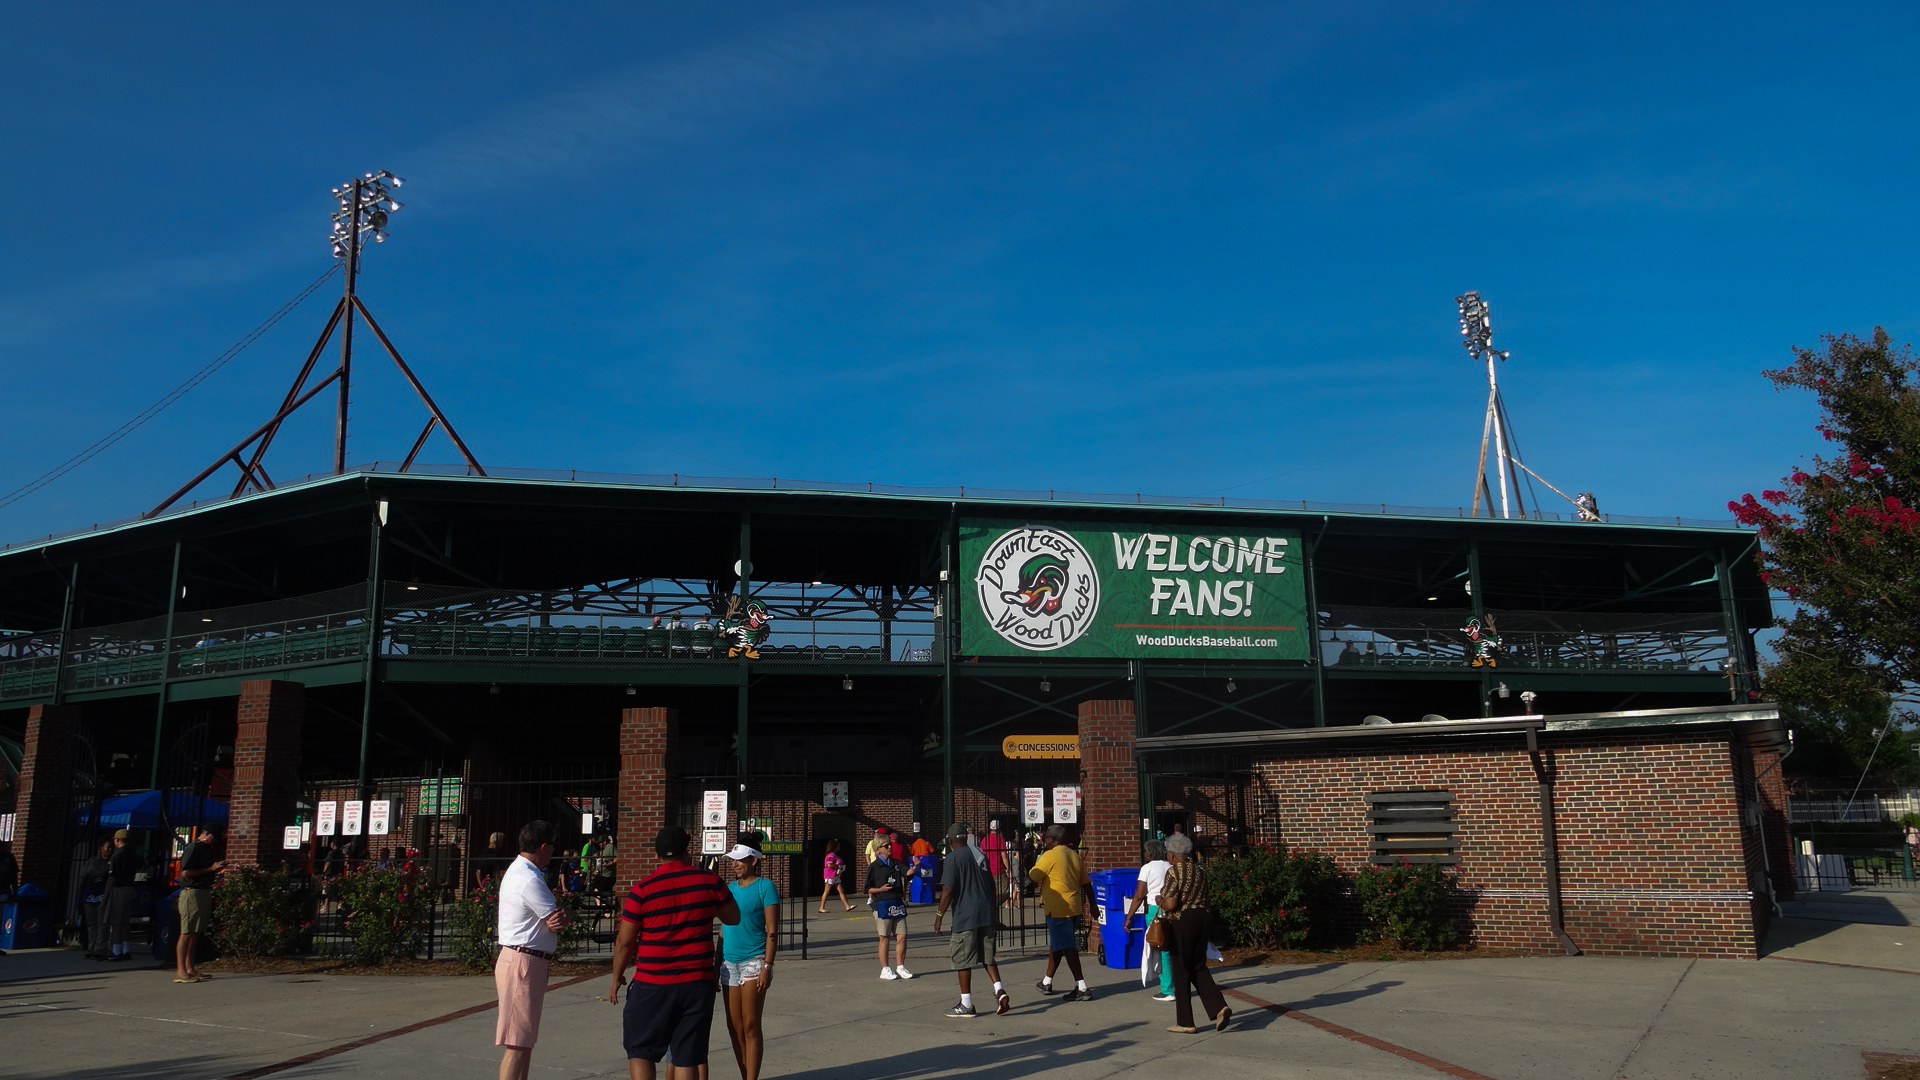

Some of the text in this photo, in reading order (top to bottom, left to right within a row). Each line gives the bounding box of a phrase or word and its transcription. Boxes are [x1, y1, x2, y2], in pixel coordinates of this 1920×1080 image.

[1112, 532, 1288, 574] WELCOME
[995, 573, 1091, 643] Wood Ducks
[1150, 576, 1254, 617] FANS!
[1136, 634, 1278, 647] WoodDucksBaseball.com
[1017, 743, 1075, 752] CONCESSIONS
